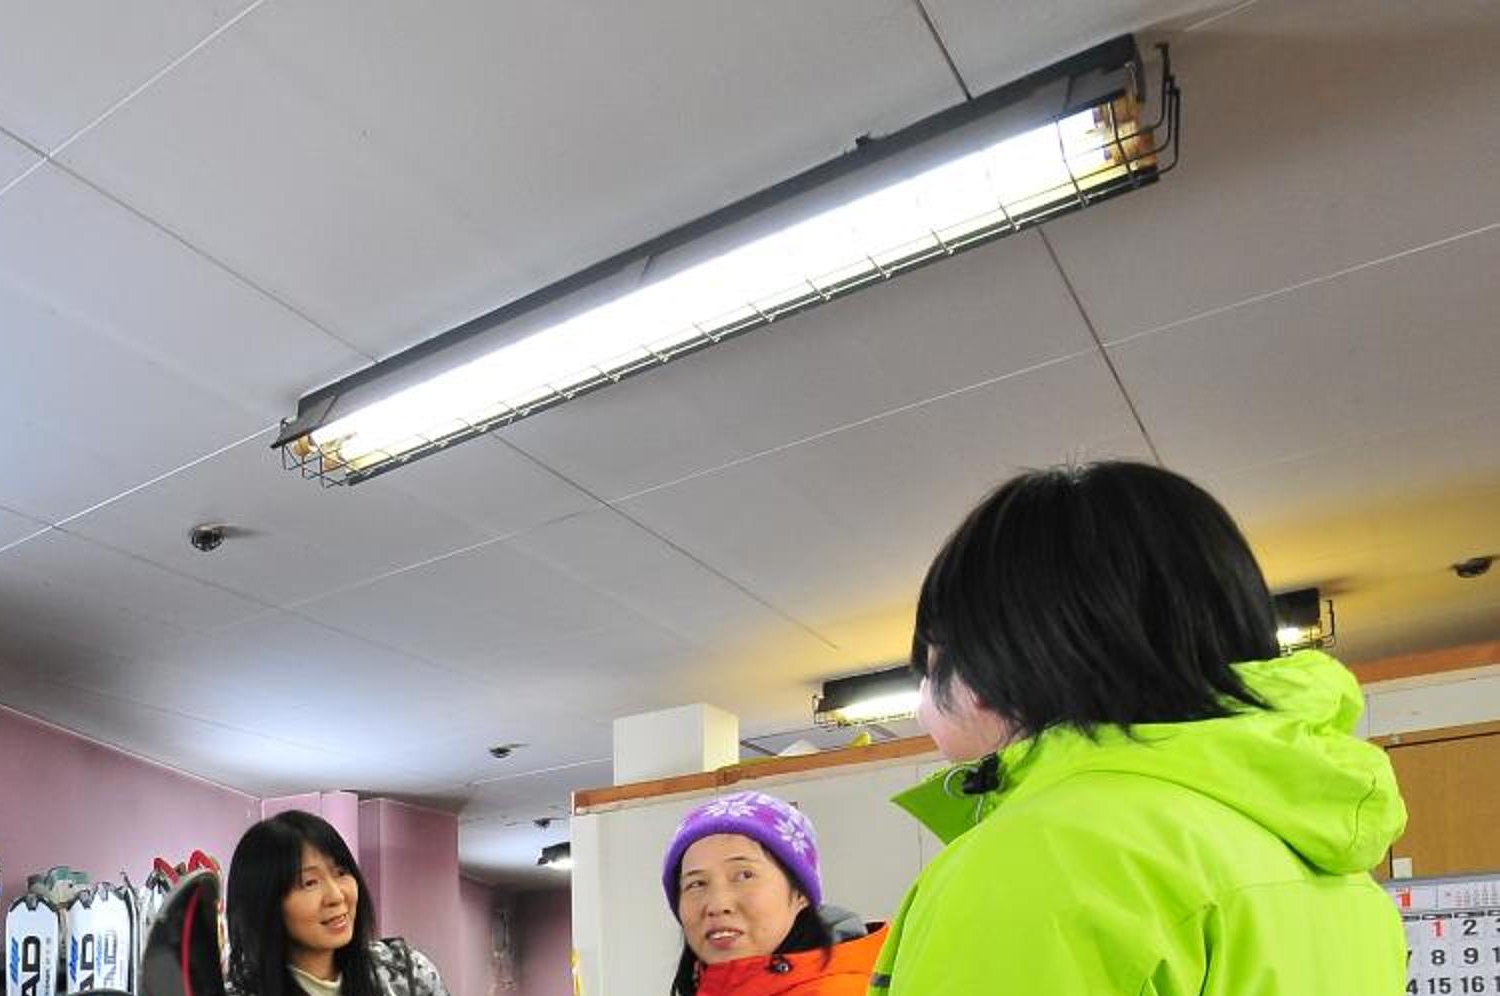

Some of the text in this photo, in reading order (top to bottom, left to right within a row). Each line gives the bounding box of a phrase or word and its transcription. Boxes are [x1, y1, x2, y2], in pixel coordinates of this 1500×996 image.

[1432, 919, 1441, 937] 1
[1463, 919, 1478, 936] 2
[1431, 949, 1446, 966] 8
[1463, 947, 1479, 965] 9
[1405, 978, 1418, 995] 4
[1427, 977, 1451, 995] 15
[1460, 975, 1485, 993] 16
